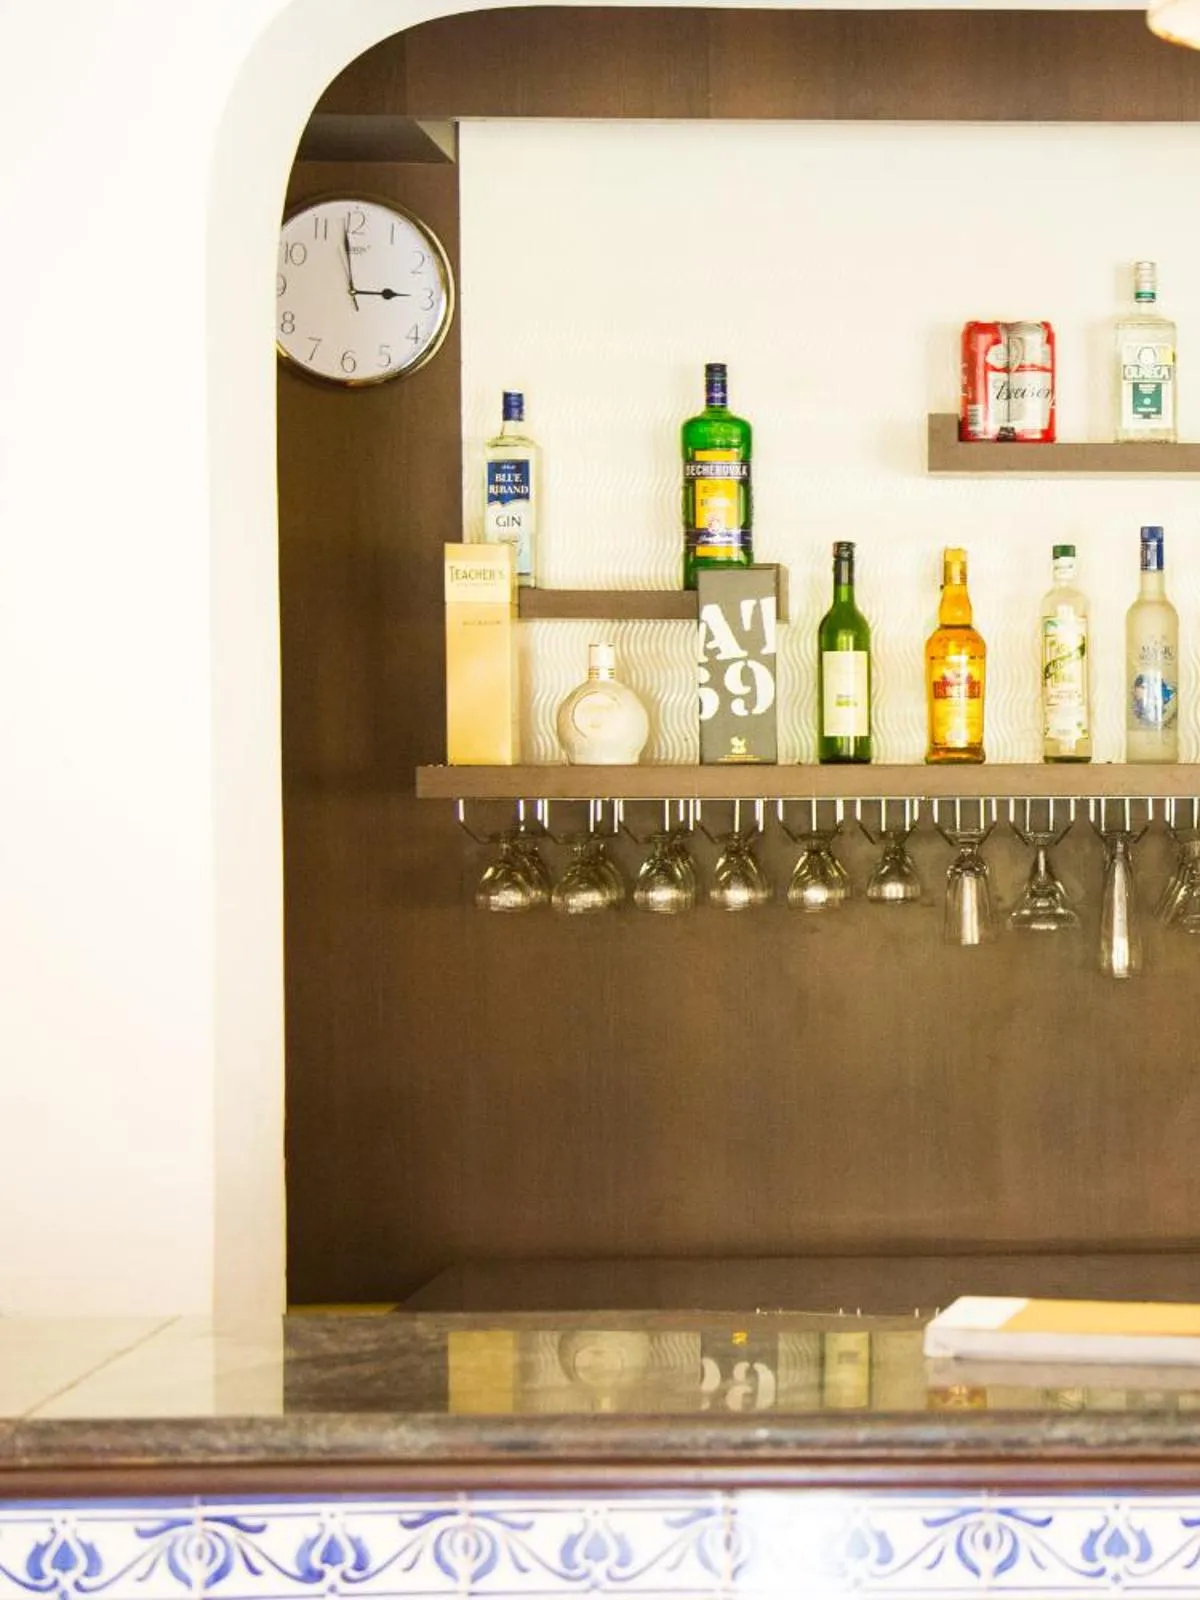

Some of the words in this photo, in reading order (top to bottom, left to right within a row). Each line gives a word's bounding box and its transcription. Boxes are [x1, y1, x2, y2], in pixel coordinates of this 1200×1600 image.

[314, 216, 328, 241] 11
[346, 211, 366, 235] 12
[283, 240, 308, 266] 10
[410, 251, 426, 275] 2
[420, 288, 435, 311] 3
[280, 311, 296, 335] 8
[405, 323, 420, 345] 4
[306, 337, 323, 361] 7
[378, 345, 392, 368] 5
[340, 350, 357, 373] 6
[495, 473, 523, 482] BLUE
[489, 485, 529, 495] RIBAND
[495, 515, 522, 528] GIN
